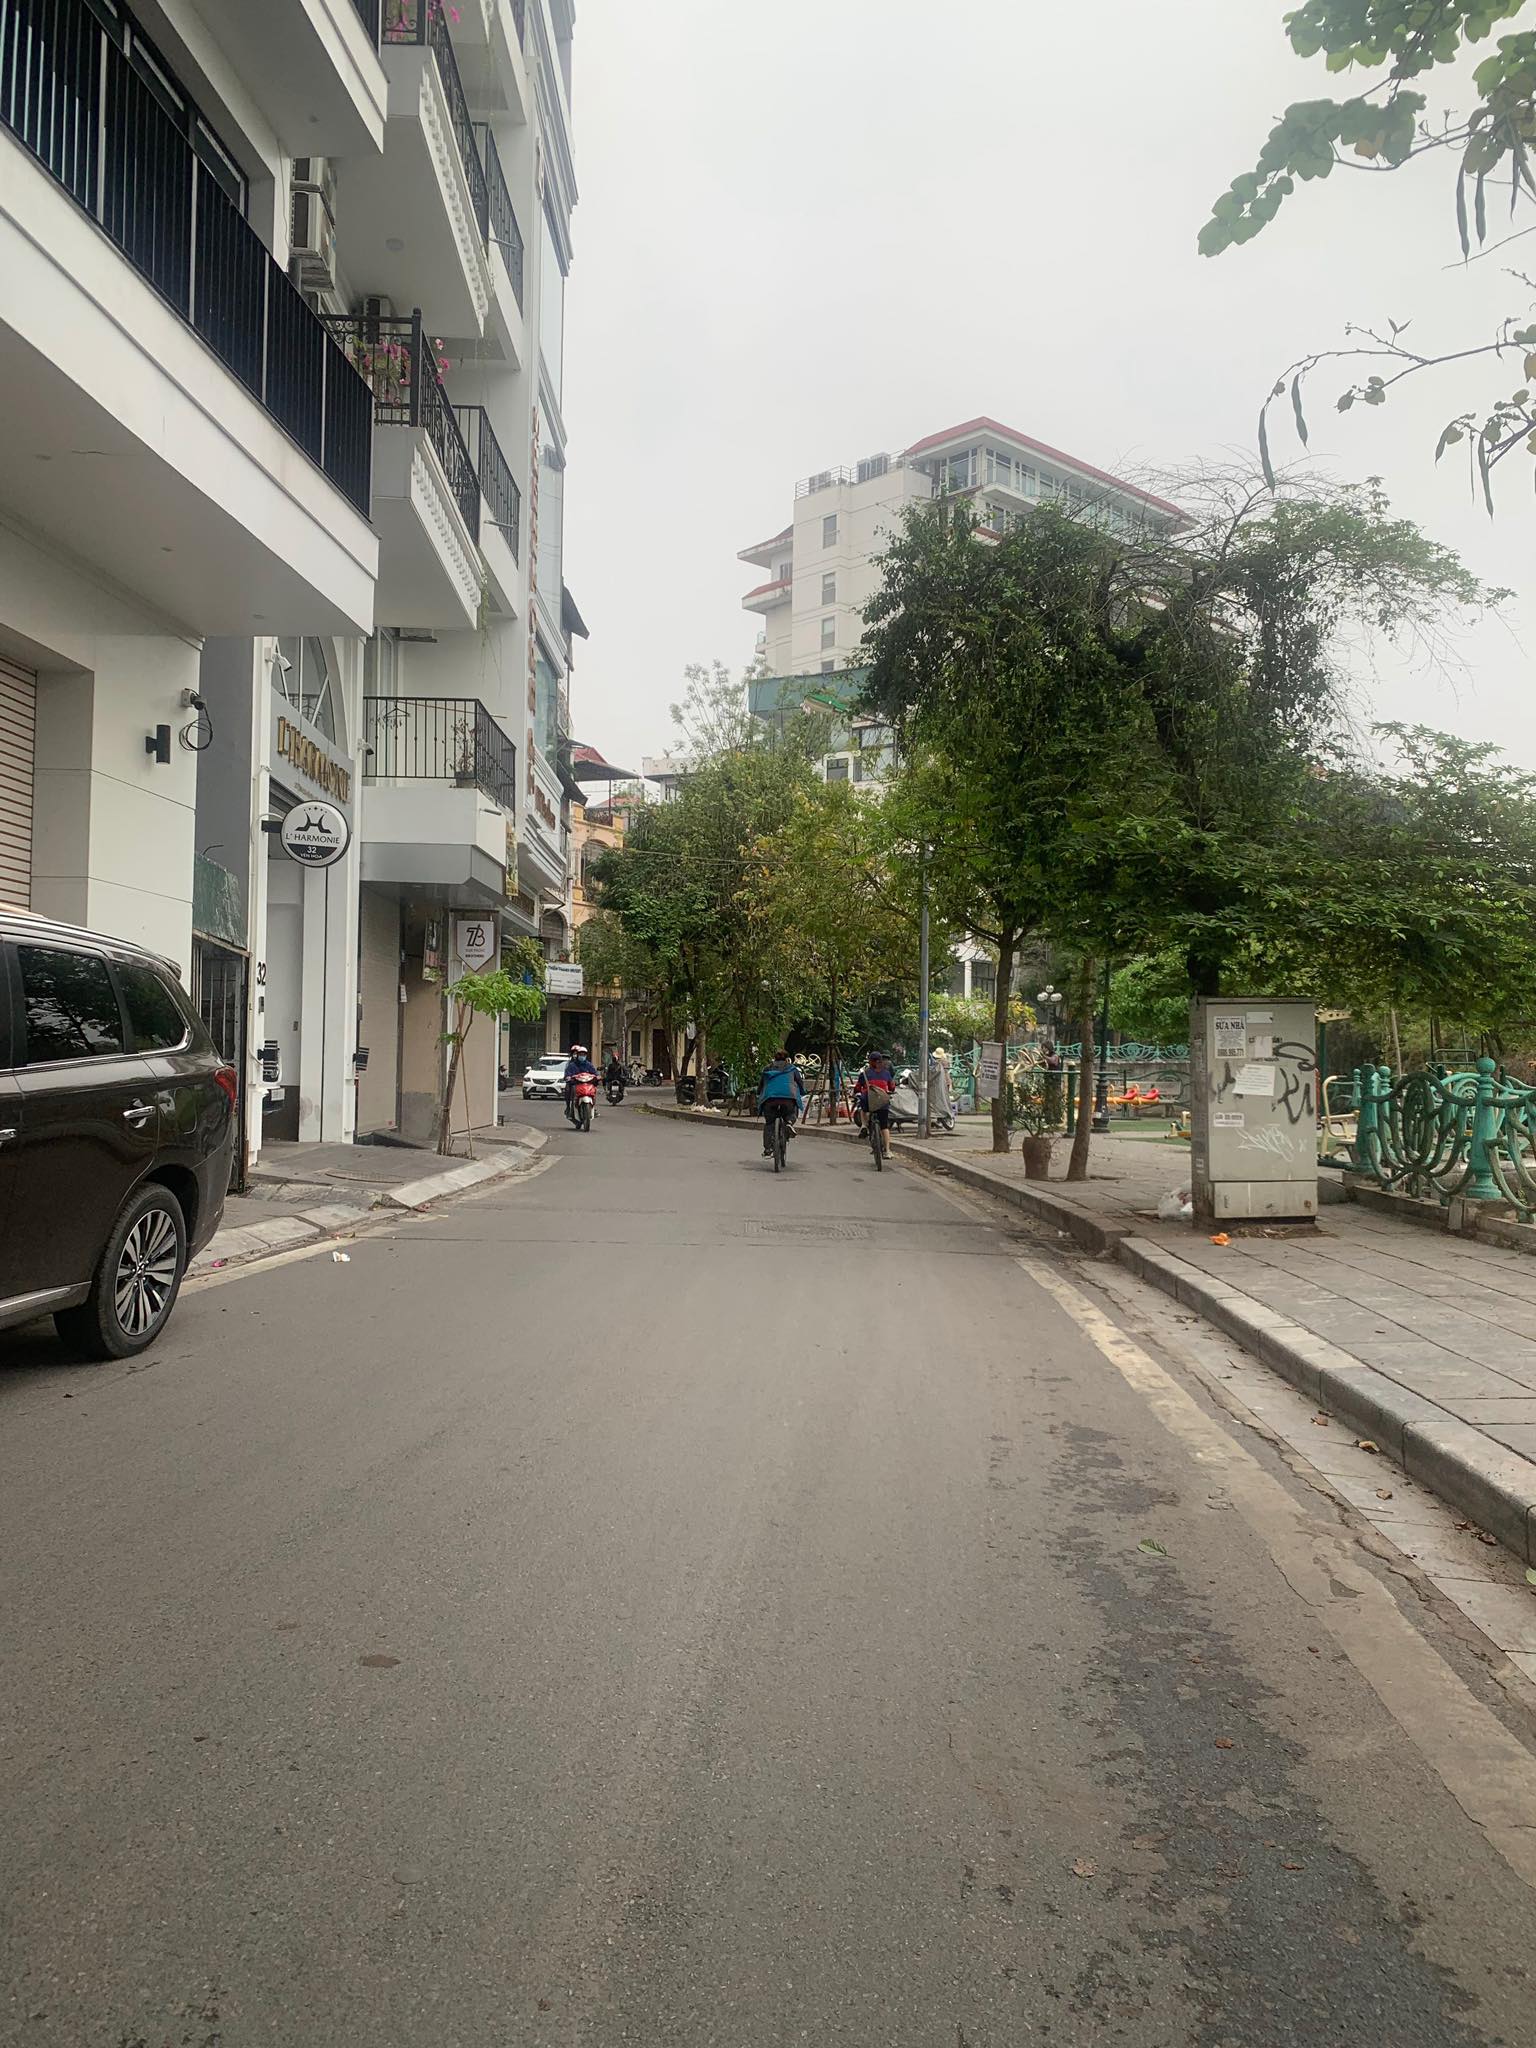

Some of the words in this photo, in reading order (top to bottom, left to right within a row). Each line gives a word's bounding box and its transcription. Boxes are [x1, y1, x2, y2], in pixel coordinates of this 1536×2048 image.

[294, 833, 340, 844] HARMONIE
[307, 846, 317, 854] 32
[257, 962, 267, 986] 32
